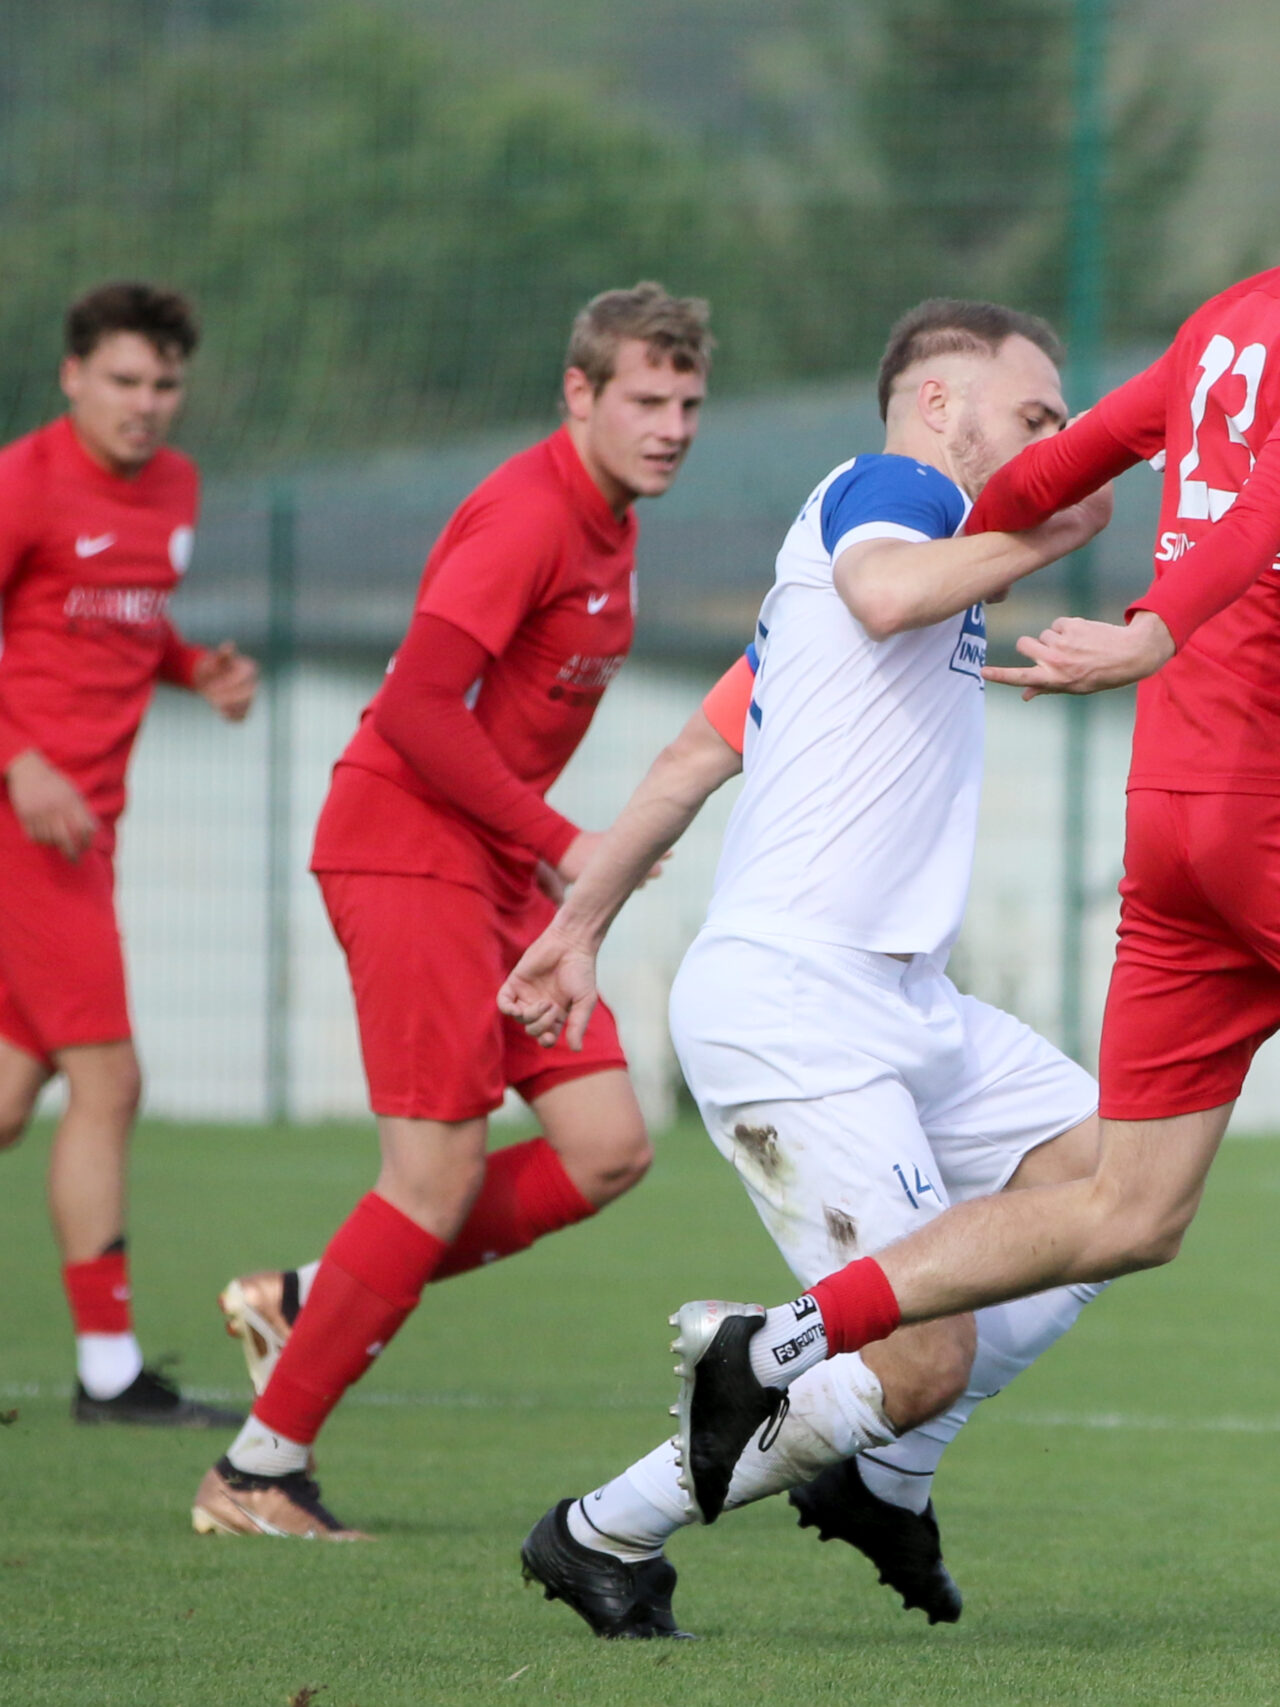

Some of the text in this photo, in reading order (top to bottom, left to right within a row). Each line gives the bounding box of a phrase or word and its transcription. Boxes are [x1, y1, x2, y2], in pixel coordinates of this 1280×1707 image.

[1177, 334, 1267, 523] 23
[893, 1162, 942, 1209] 14
[773, 1341, 798, 1363] FS
